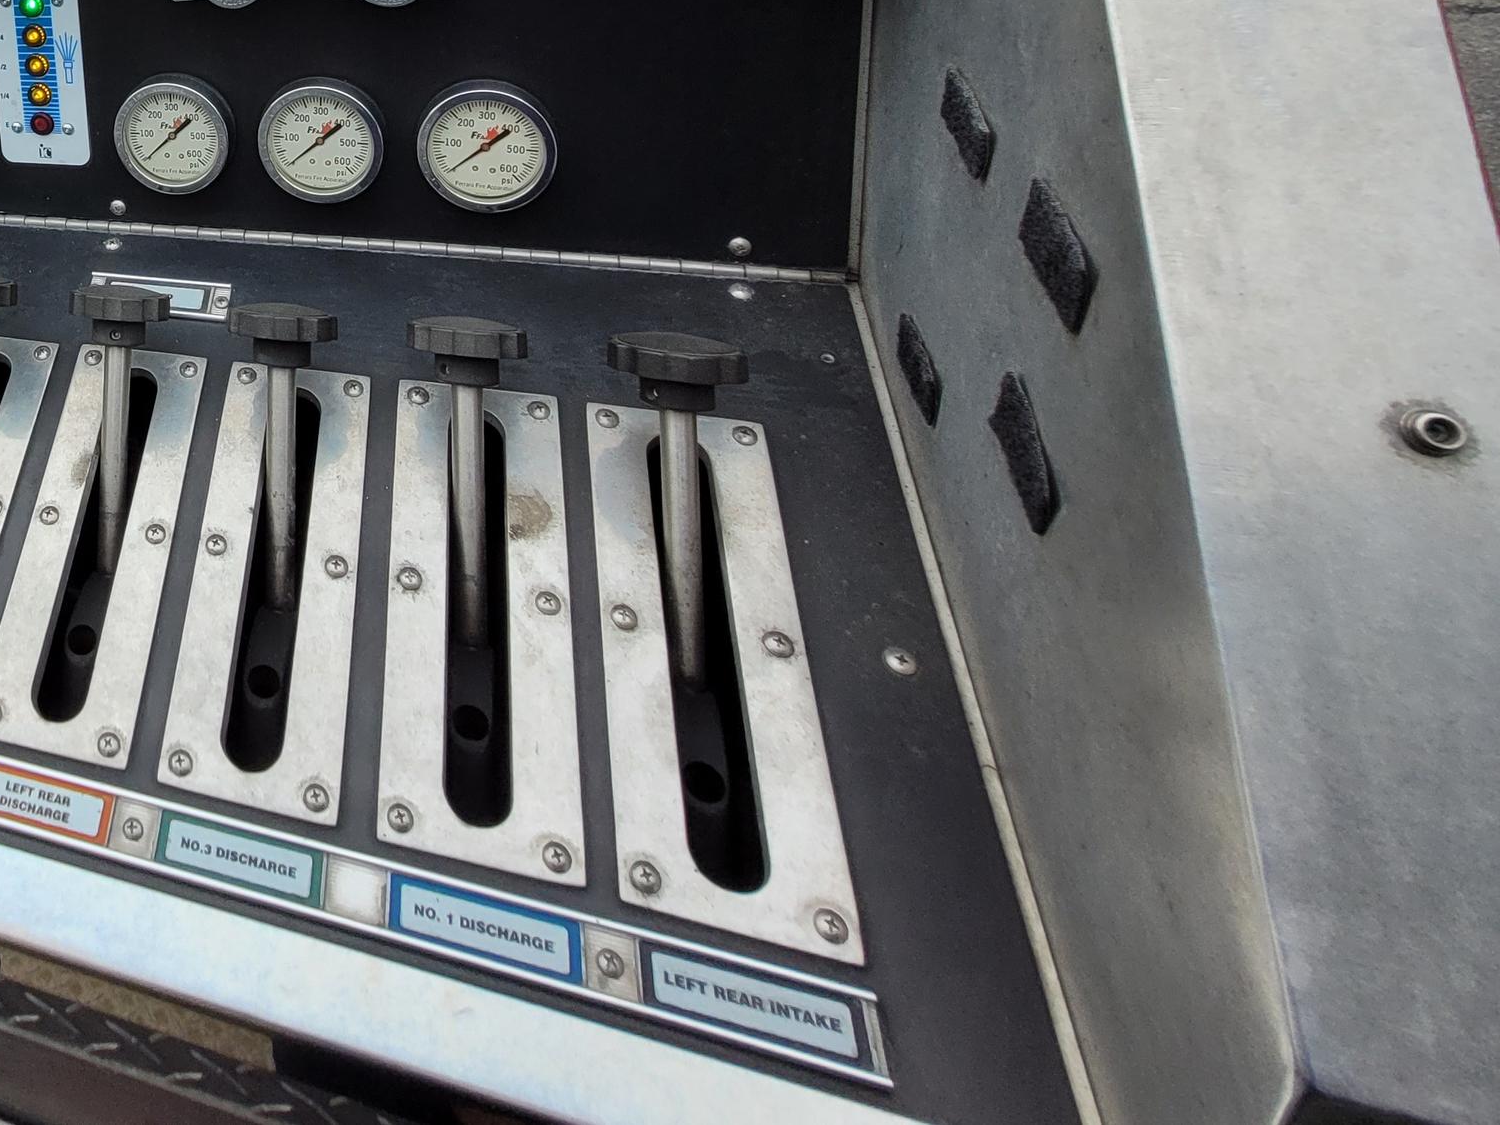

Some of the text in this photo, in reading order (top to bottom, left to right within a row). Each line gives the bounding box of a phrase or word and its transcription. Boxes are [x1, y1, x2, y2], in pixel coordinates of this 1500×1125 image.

[164, 103, 178, 111] 300
[313, 107, 328, 115] 300
[294, 114, 310, 122] 200
[478, 111, 496, 120] 300
[334, 119, 350, 127] 400
[457, 118, 474, 127] 200
[502, 124, 520, 133] 400
[190, 132, 205, 140] 500
[284, 133, 299, 141] 100
[340, 139, 356, 147] 500
[445, 138, 462, 147] 100
[187, 150, 201, 158] 600
[507, 145, 525, 154] 500
[334, 157, 351, 165] 600
[500, 164, 518, 174] 600
[502, 177, 513, 185] psi
[5, 781, 70, 807] LEFT REAR
[0, 795, 69, 823] DISCHARGE
[181, 837, 297, 878] NO.3 DISCHARGE
[414, 905, 555, 954] NO. 1 DISCHARGE
[664, 971, 842, 1034] LEFT REAR INTAKE
